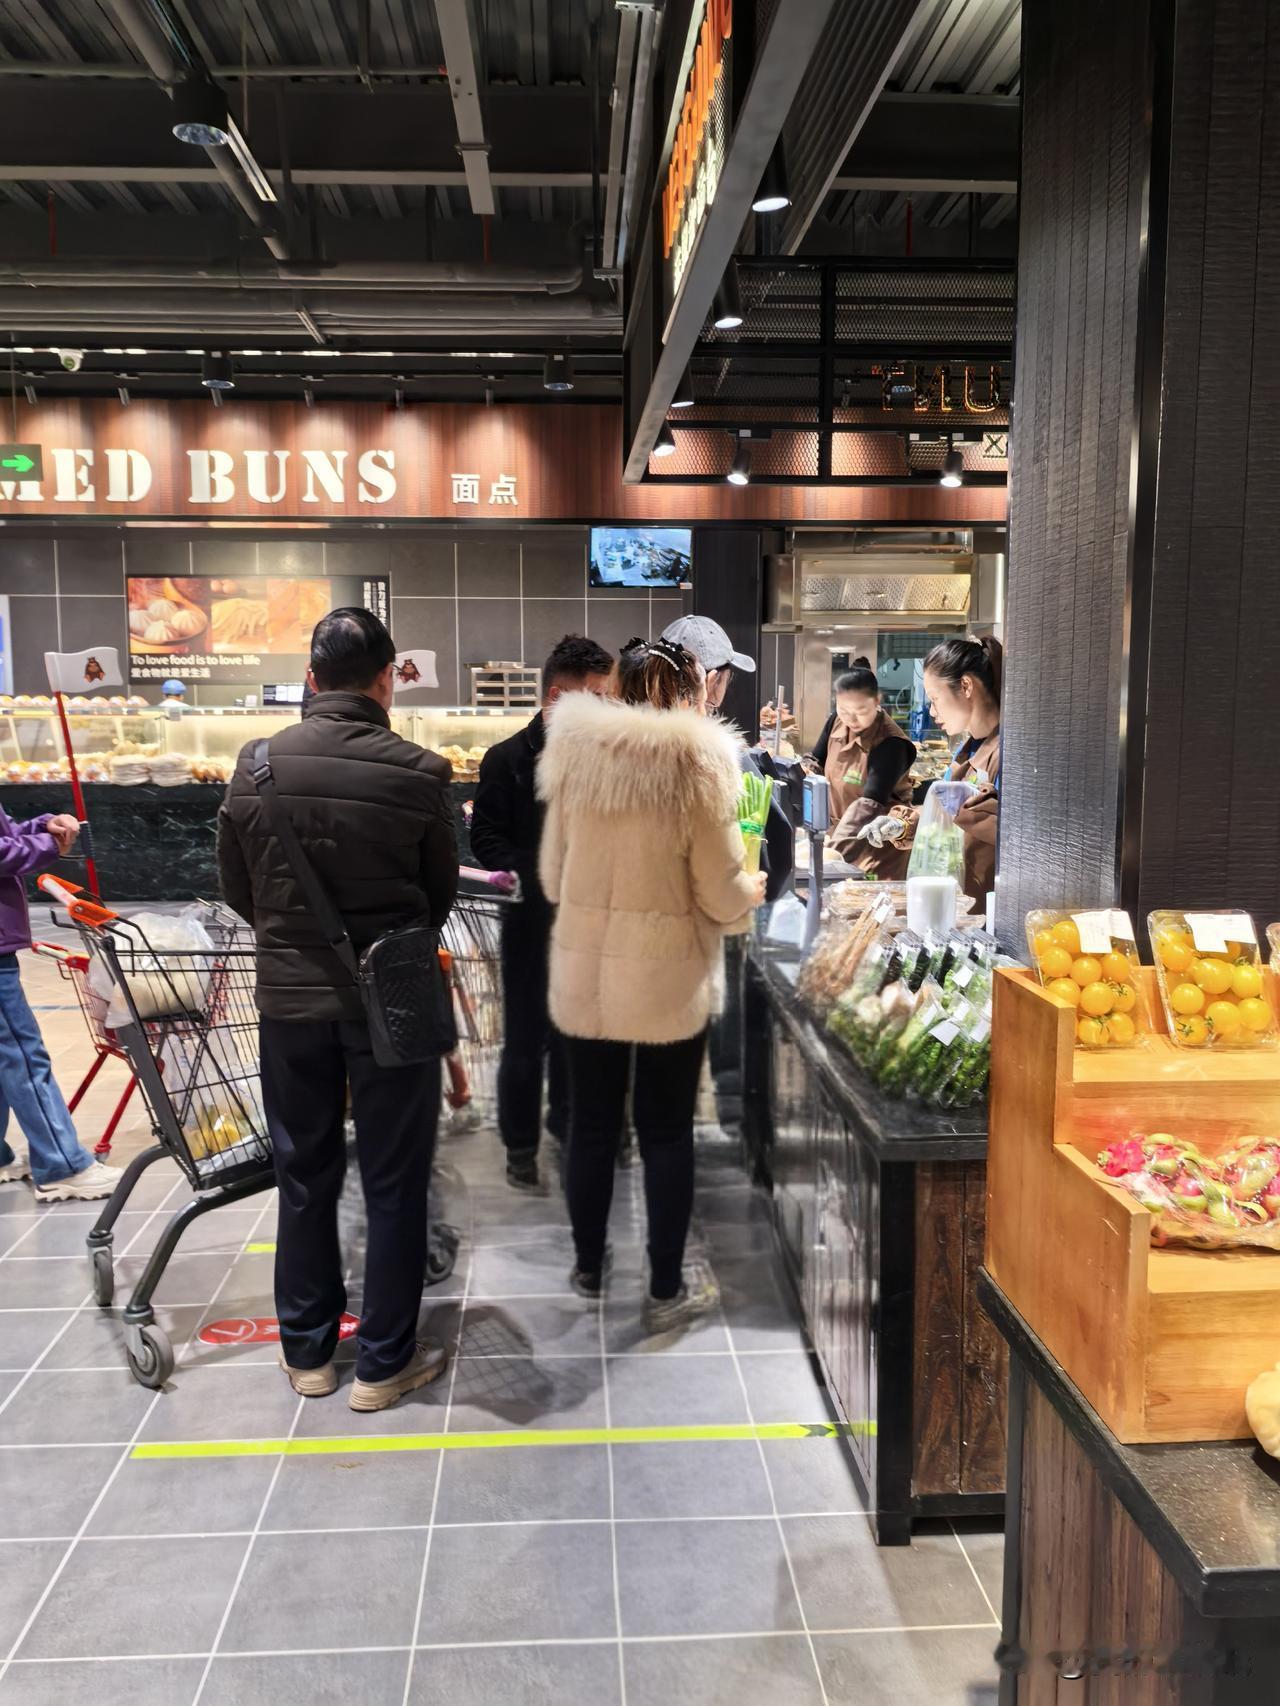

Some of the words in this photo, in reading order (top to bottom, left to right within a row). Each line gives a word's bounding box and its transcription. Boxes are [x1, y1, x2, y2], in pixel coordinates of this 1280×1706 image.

[186, 449, 397, 504] BUNS
[450, 473, 519, 506] 面点
[131, 655, 145, 665] To
[146, 655, 169, 665] love
[170, 655, 195, 665] food
[196, 655, 206, 665] is
[207, 655, 219, 665] to
[219, 655, 242, 665] love
[243, 655, 261, 665] life
